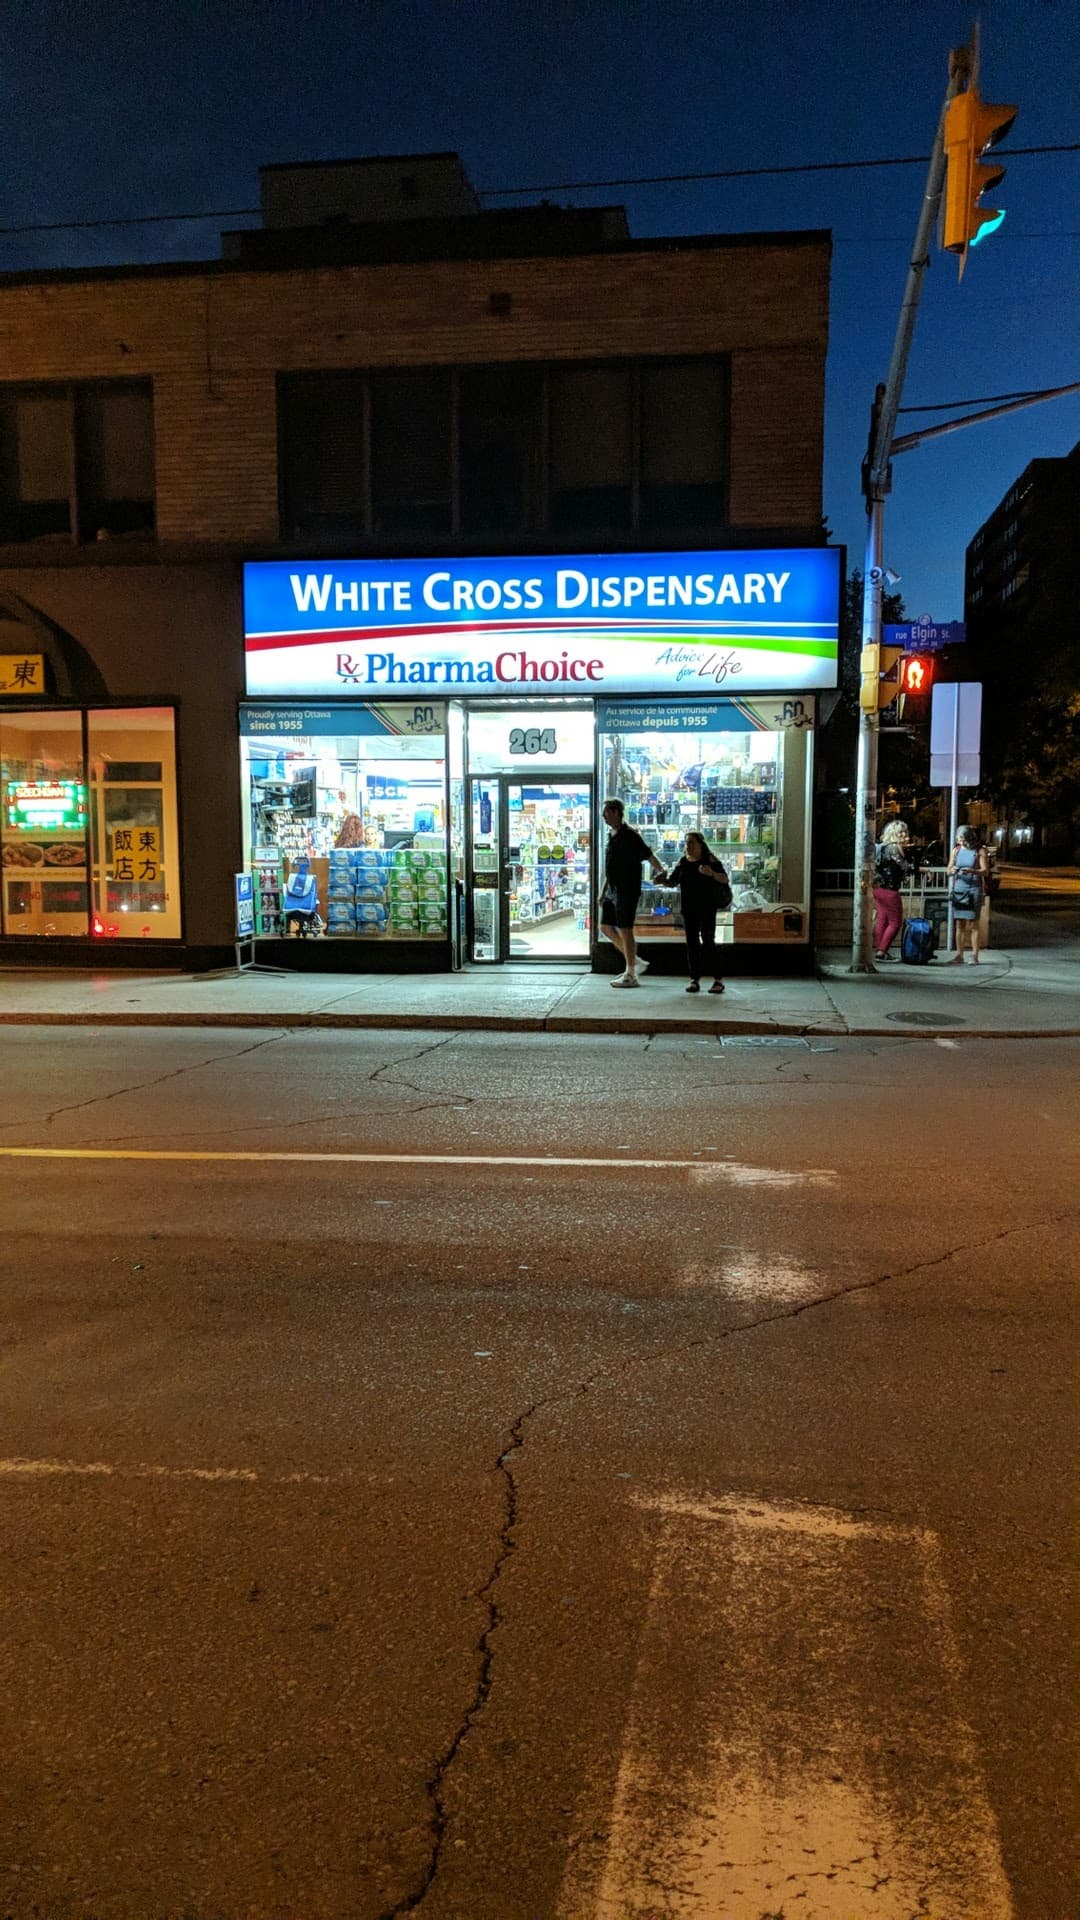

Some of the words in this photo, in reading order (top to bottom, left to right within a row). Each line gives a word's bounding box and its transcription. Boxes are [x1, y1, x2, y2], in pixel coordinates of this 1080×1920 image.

[290, 574, 412, 612] WHITE
[422, 572, 544, 611] CROSS
[556, 569, 791, 609] DISPENSARY
[895, 632, 908, 640] rue
[911, 625, 937, 642] Elgin
[655, 646, 704, 665] Advice
[8, 659, 41, 689] 東
[365, 651, 604, 684] PharmaChoice
[675, 664, 696, 682] for
[698, 651, 743, 684] Life
[247, 710, 274, 721] Proudly
[276, 710, 303, 720] serving
[304, 710, 332, 719] Ottawa
[606, 707, 617, 715] Au
[618, 707, 644, 715] service
[646, 706, 657, 715] de
[658, 706, 665, 714] la
[666, 705, 718, 714] communauté
[249, 720, 276, 730] since
[278, 720, 303, 730] 1955
[606, 718, 641, 727] d'Ottawa
[642, 716, 679, 728] depuis
[682, 716, 708, 726] 1955
[509, 728, 557, 755] 264
